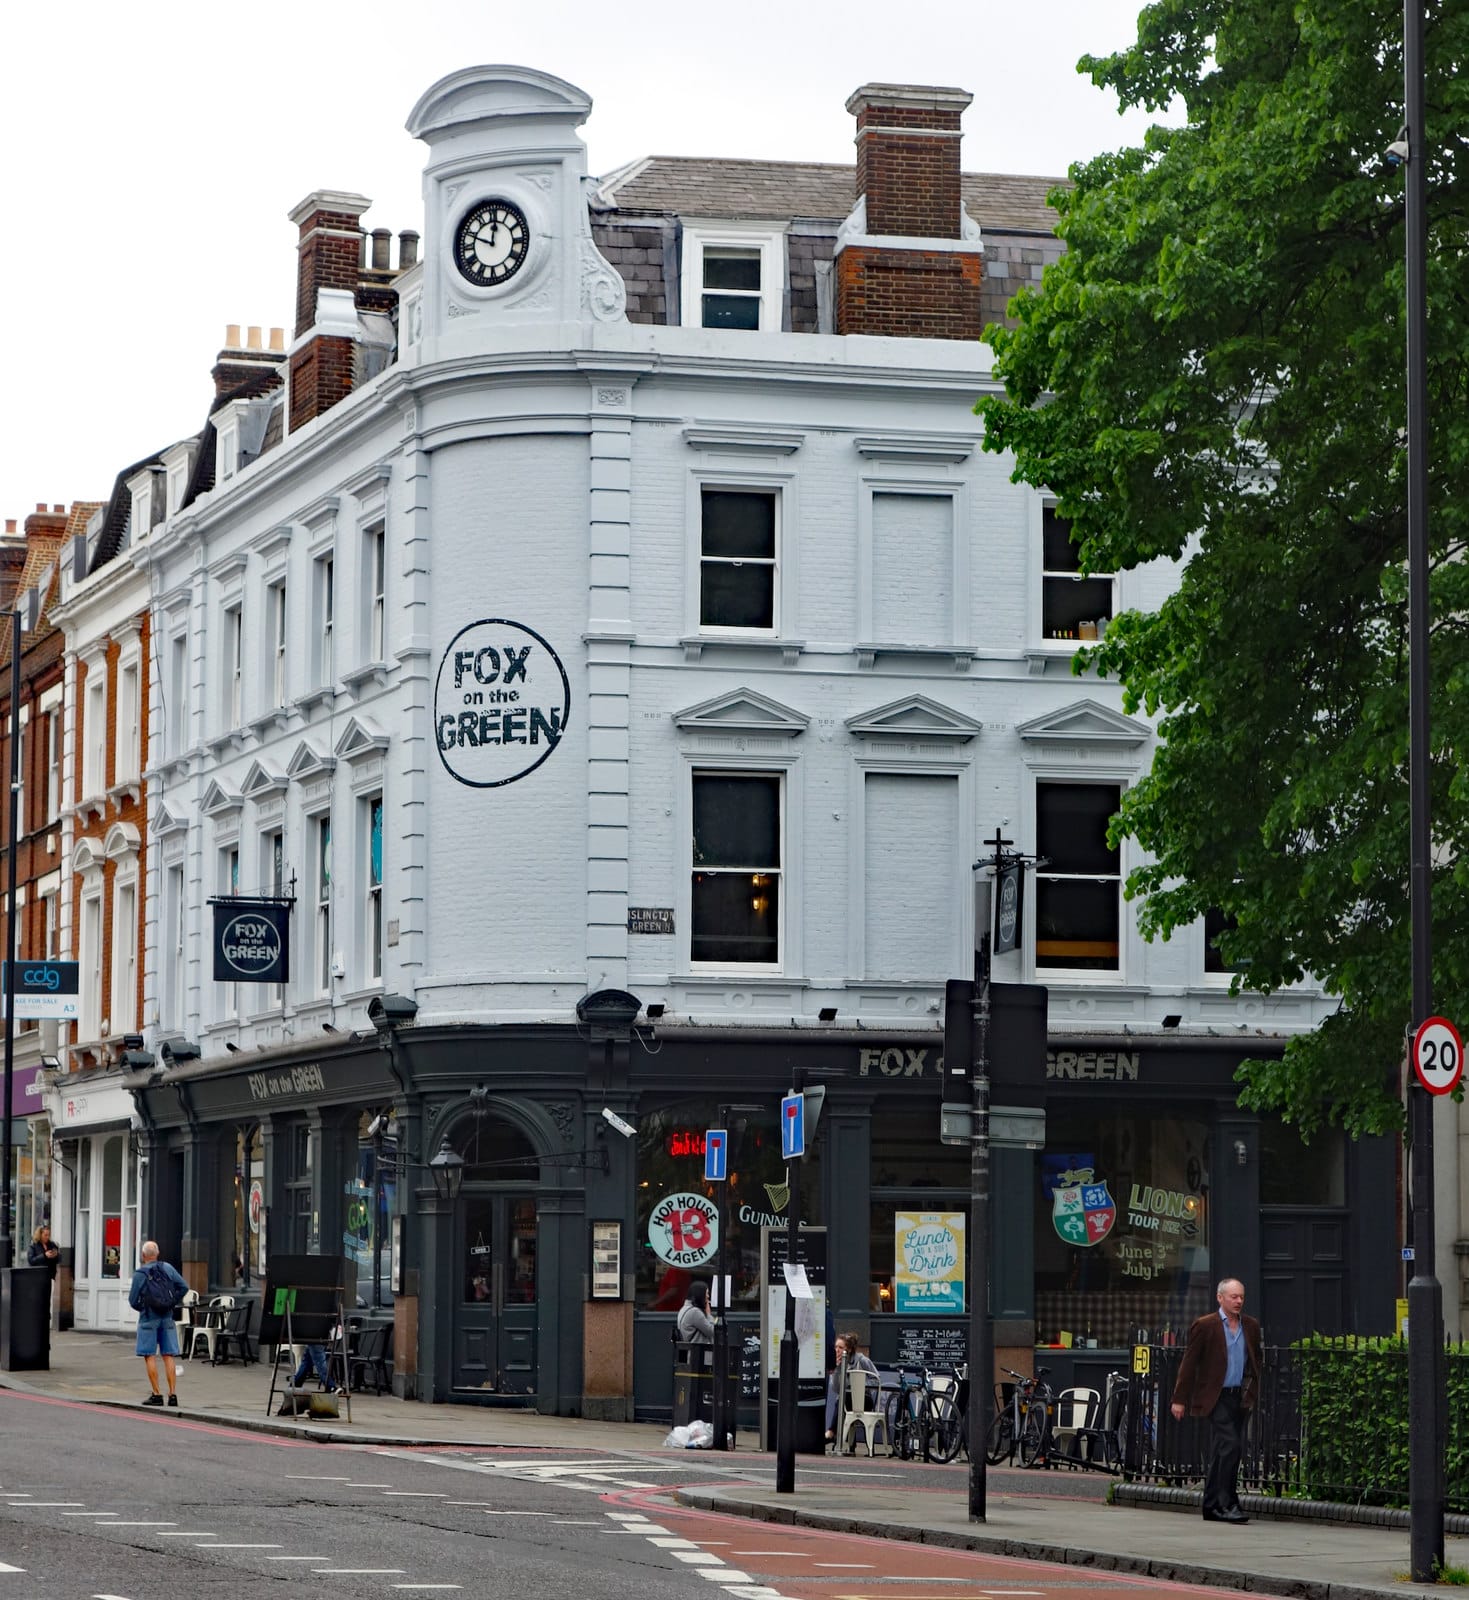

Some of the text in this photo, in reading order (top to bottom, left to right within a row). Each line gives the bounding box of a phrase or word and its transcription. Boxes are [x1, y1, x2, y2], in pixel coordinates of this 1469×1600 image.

[455, 646, 532, 688] FOX
[463, 689, 519, 705] on the
[438, 707, 561, 751] GREEN
[235, 923, 268, 938] FOX
[632, 921, 661, 932] GREEN
[225, 944, 280, 961] GREEN
[24, 965, 59, 990] cdg
[859, 1048, 928, 1077] FOX
[1422, 1040, 1456, 1071] 20
[248, 1073, 269, 1100] FOX
[290, 1064, 325, 1094] GREEN
[653, 1196, 718, 1227] HOP HOUSE
[1129, 1183, 1199, 1220] LIONS
[663, 1208, 711, 1252] 13
[1127, 1212, 1160, 1231] TOUR
[904, 1227, 953, 1248] Lunch
[665, 1247, 708, 1264] LAGER
[1115, 1243, 1153, 1259] June
[909, 1253, 957, 1273] Drink
[1121, 1261, 1151, 1281] July
